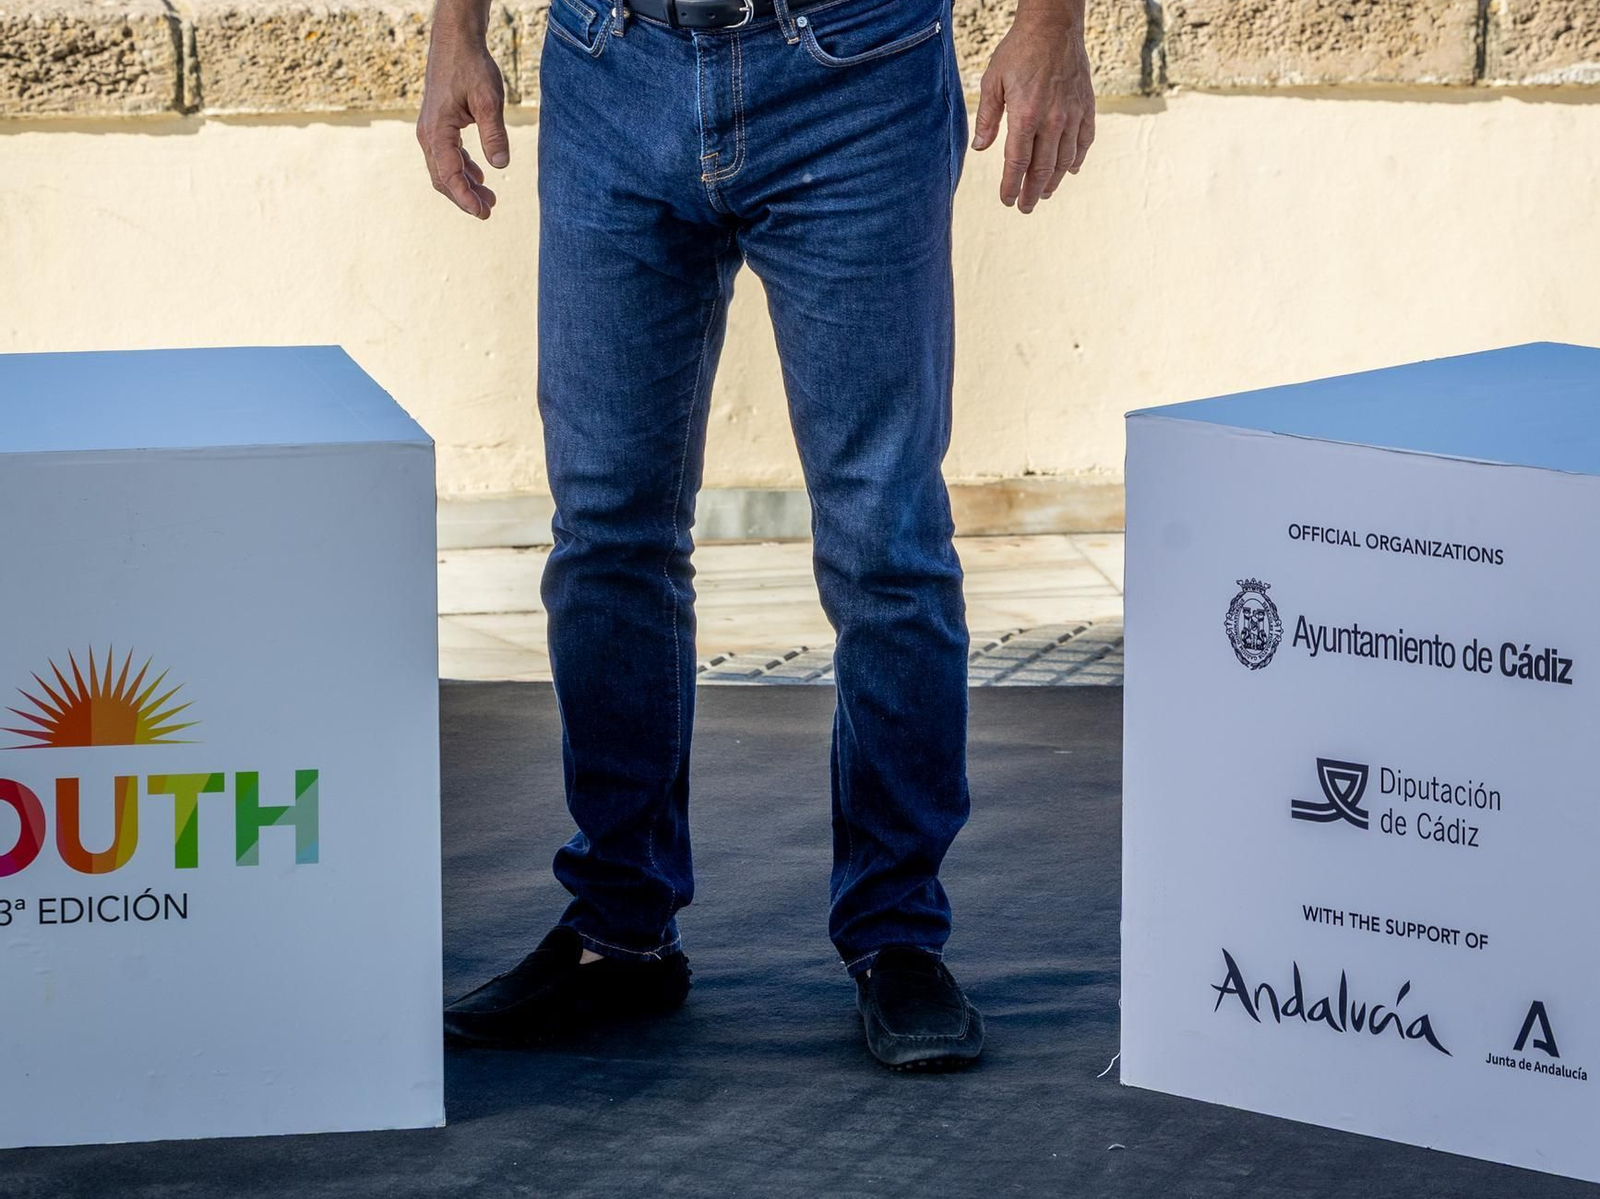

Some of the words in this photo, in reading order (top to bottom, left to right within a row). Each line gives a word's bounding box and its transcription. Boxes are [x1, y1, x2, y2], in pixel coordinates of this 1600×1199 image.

[1288, 523, 1361, 548] OFFICIAL
[1365, 533, 1505, 566] ORGANIZATIONS
[1292, 614, 1456, 669] Ayuntamiento
[1462, 638, 1493, 674] de
[1499, 643, 1573, 686] Cádiz
[1380, 766, 1502, 812] Diputación
[1380, 807, 1407, 836] de
[1416, 812, 1479, 848] Cádiz
[38, 887, 189, 925] EDICIÓN
[1302, 904, 1344, 927] WITH
[1348, 912, 1381, 933] THE
[1385, 918, 1461, 946] SUPPORT
[1464, 931, 1489, 950] OF
[1210, 947, 1454, 1057] Andalucía
[1485, 1052, 1517, 1069] Junta
[1518, 1057, 1533, 1072] de
[1533, 1060, 1588, 1082] Andalucía
